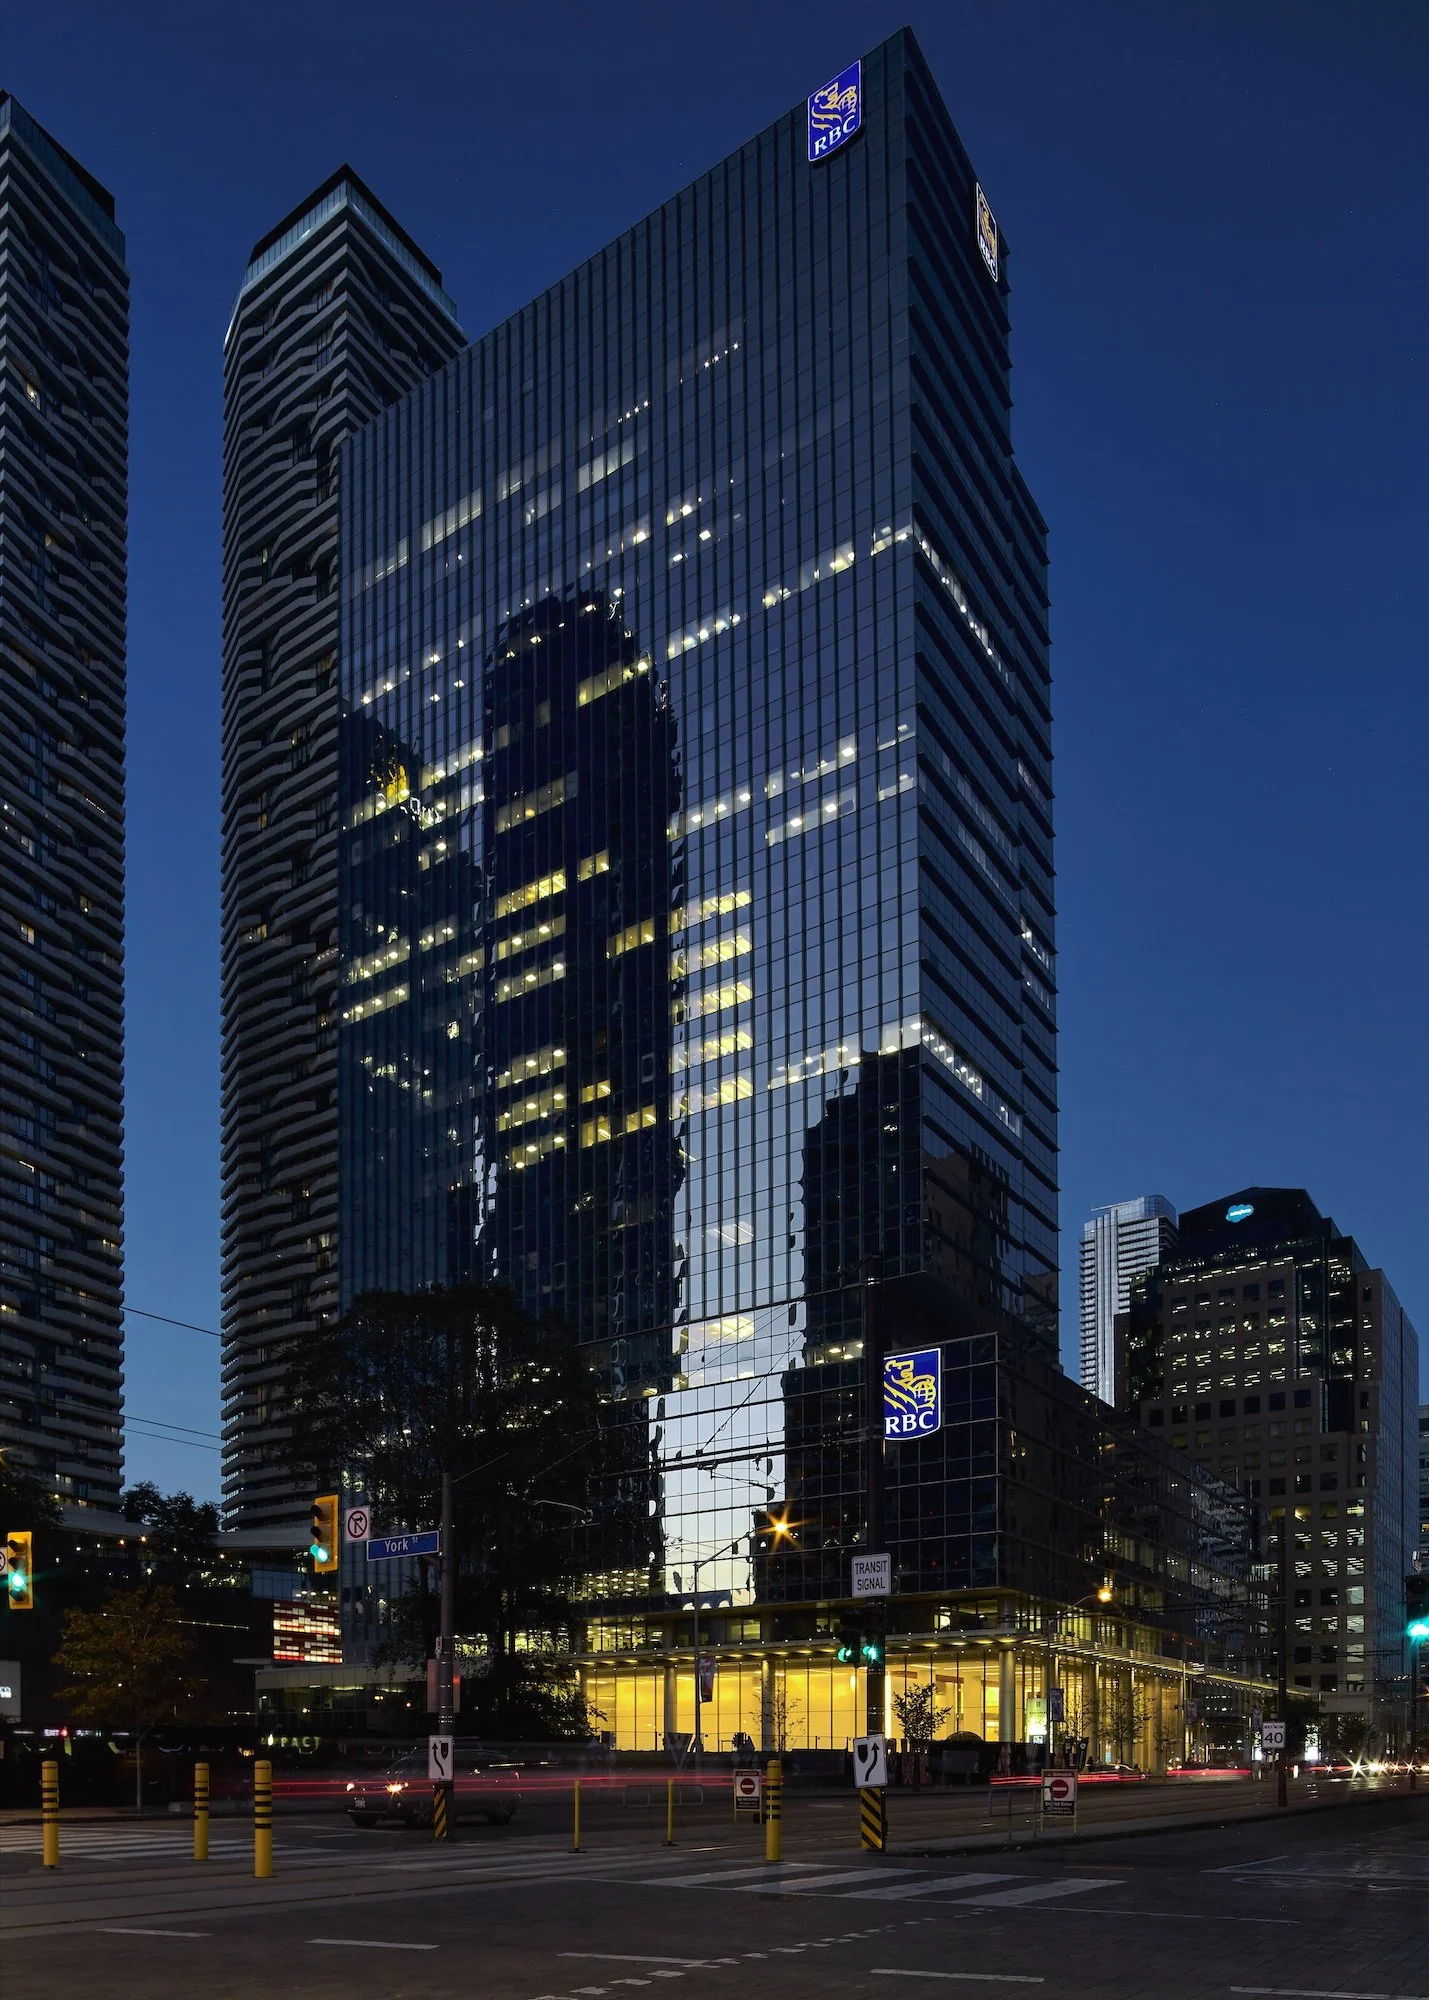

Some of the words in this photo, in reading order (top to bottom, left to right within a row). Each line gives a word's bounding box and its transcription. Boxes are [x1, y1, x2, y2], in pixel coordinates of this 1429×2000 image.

[814, 115, 855, 155] RBC
[884, 1411, 933, 1434] RBC
[384, 1538, 408, 1552] York
[855, 1561, 887, 1574] TRANSIT
[857, 1577, 885, 1590] SIGNAL
[1264, 1732, 1283, 1743] 40
